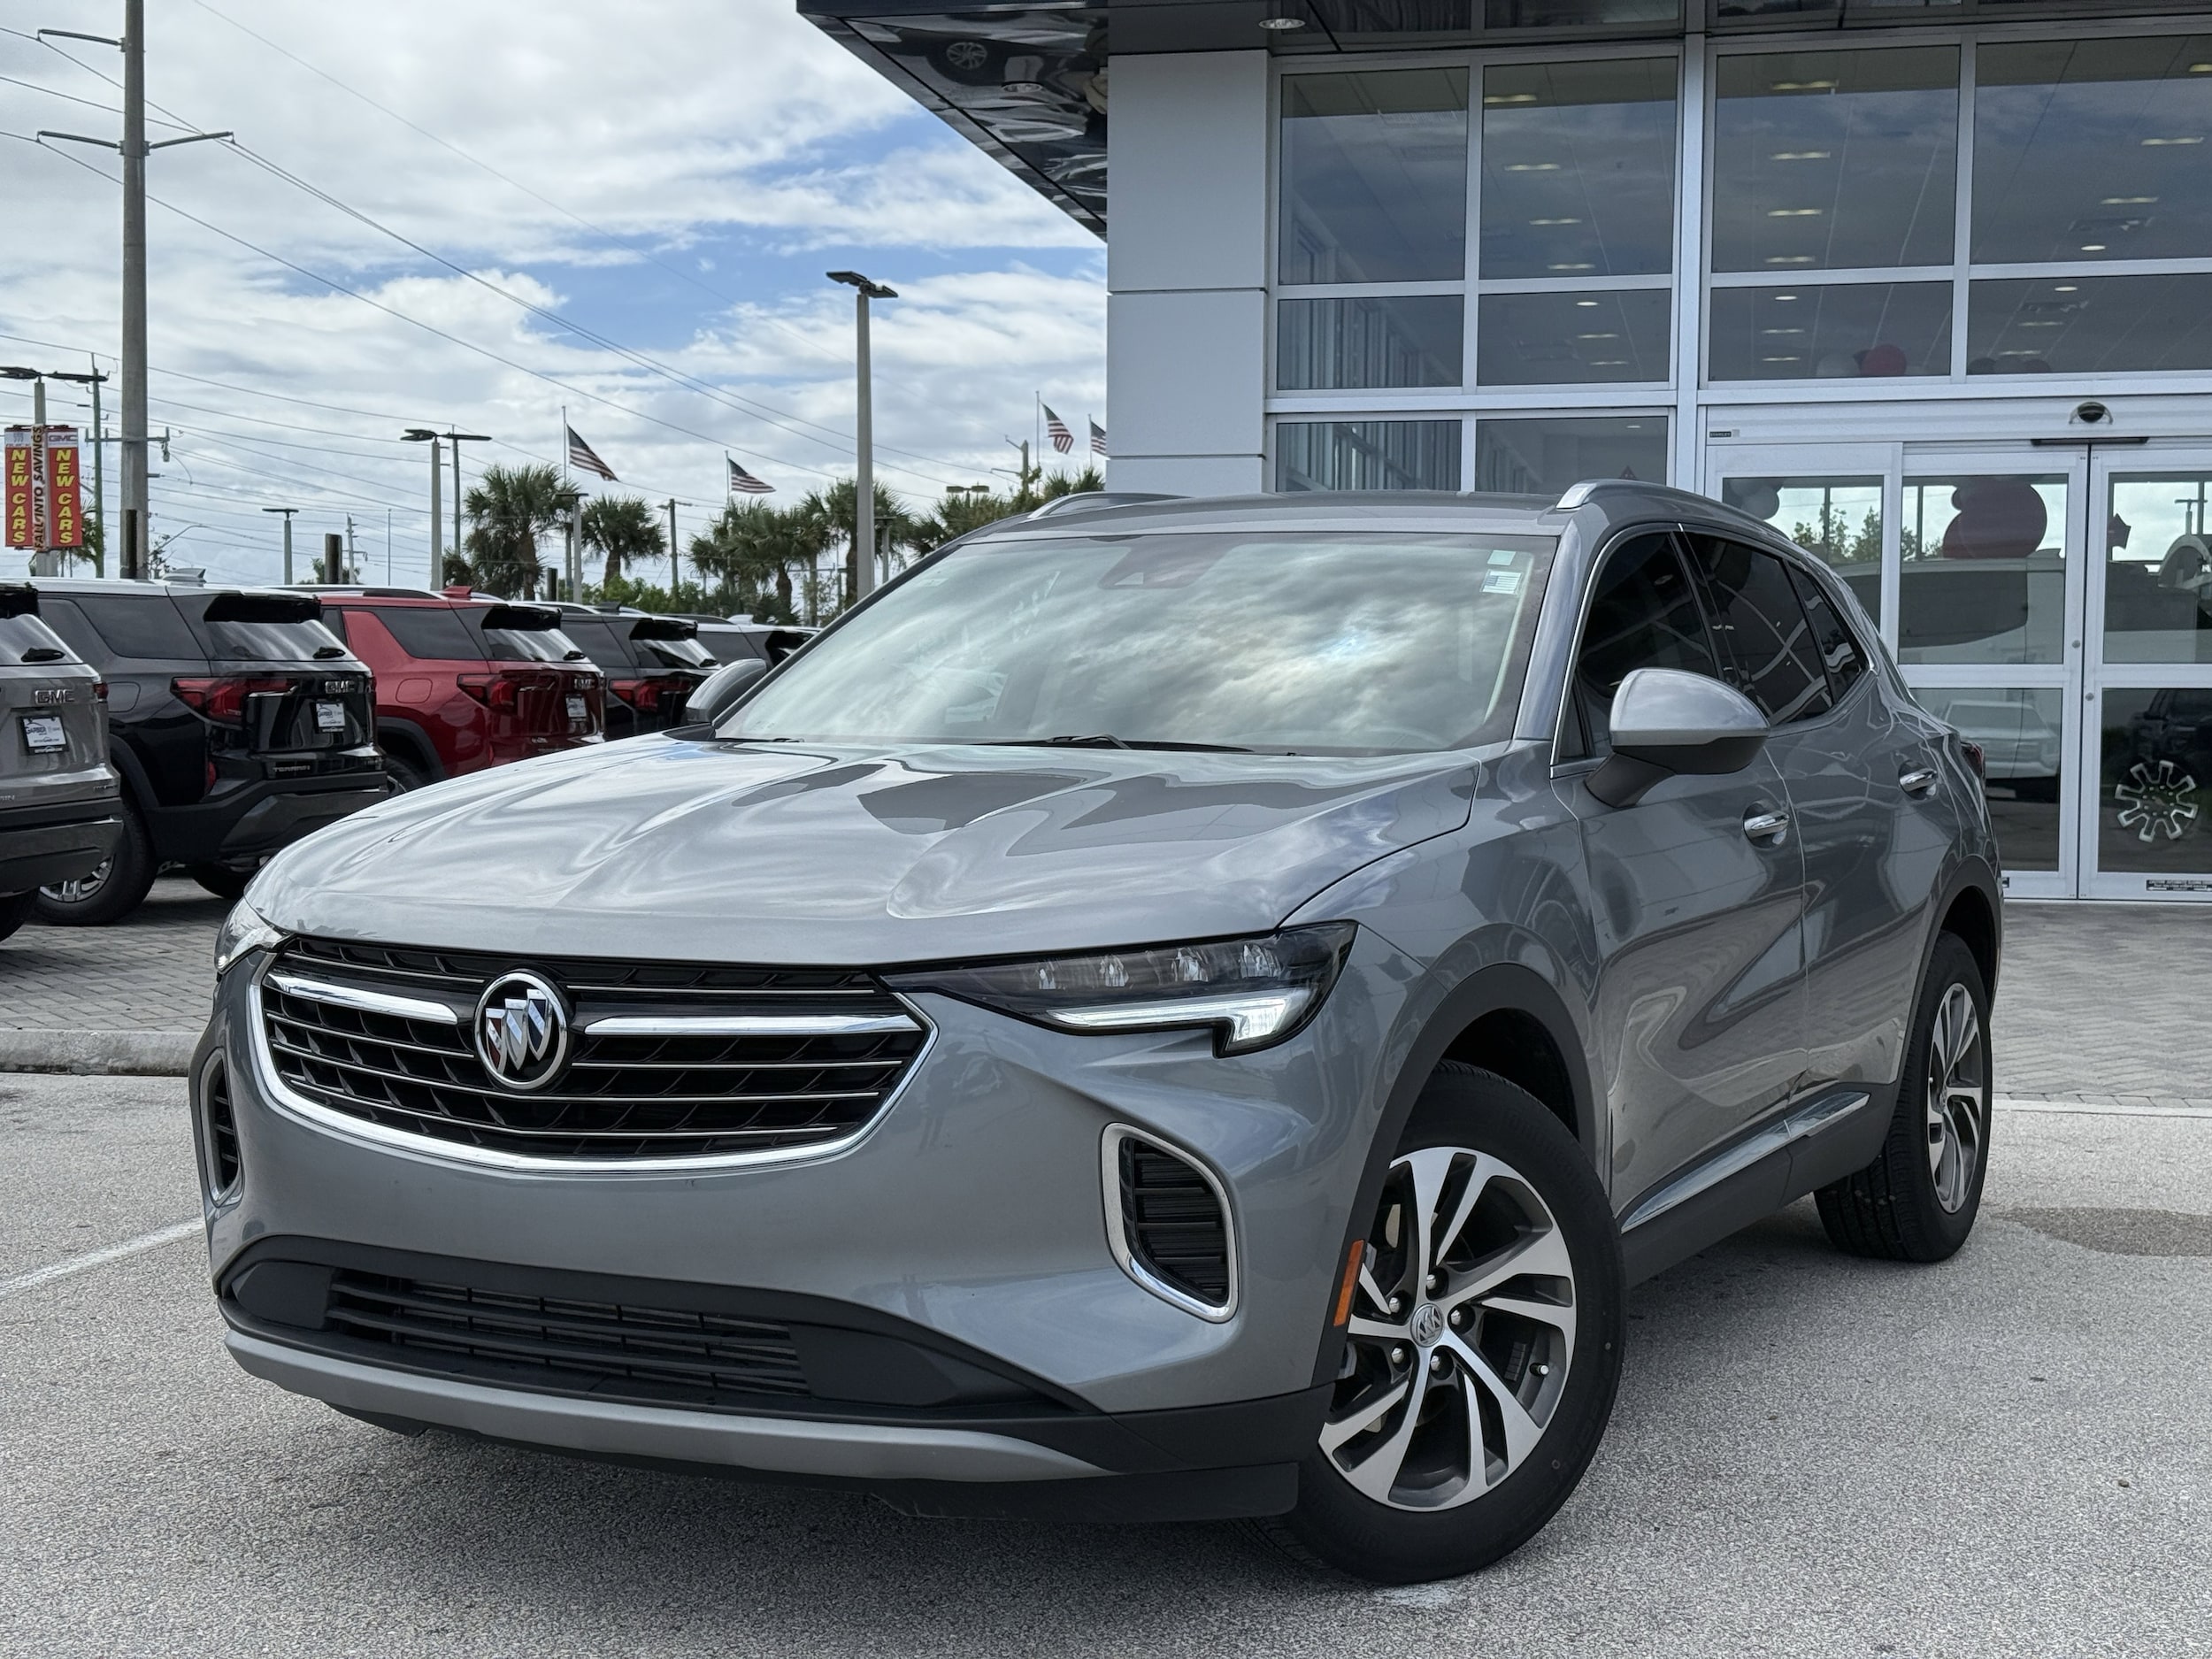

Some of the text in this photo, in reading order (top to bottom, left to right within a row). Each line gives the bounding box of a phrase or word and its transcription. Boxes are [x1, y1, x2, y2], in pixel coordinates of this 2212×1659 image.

[12, 449, 28, 487] NEW
[33, 426, 44, 549] FALL INTO SAVINGS
[56, 449, 75, 487] NEW
[12, 493, 27, 543] CARS
[58, 493, 73, 544] CARS
[35, 689, 75, 704] GMC
